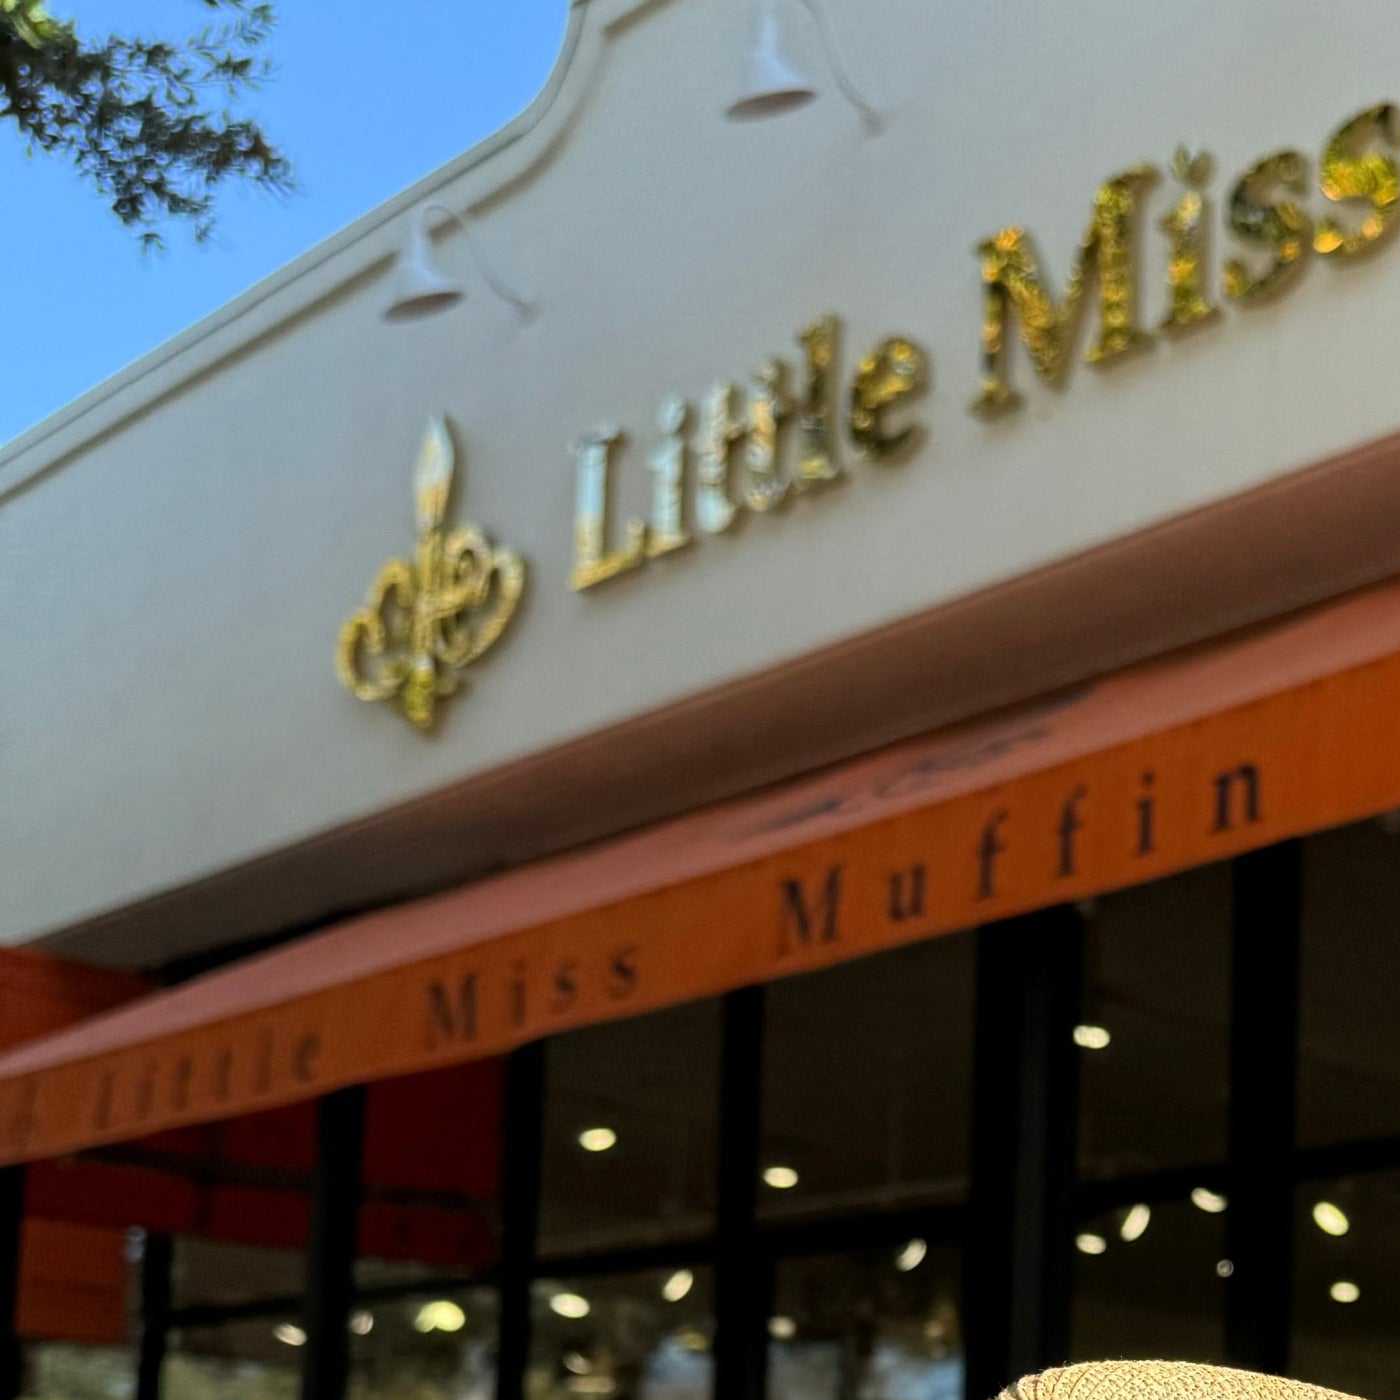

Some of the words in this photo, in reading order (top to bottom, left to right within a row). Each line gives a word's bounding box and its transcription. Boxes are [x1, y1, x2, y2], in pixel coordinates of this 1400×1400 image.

[568, 312, 924, 590] Little
[424, 944, 638, 1050] Miss
[777, 761, 1262, 956] Muffin
